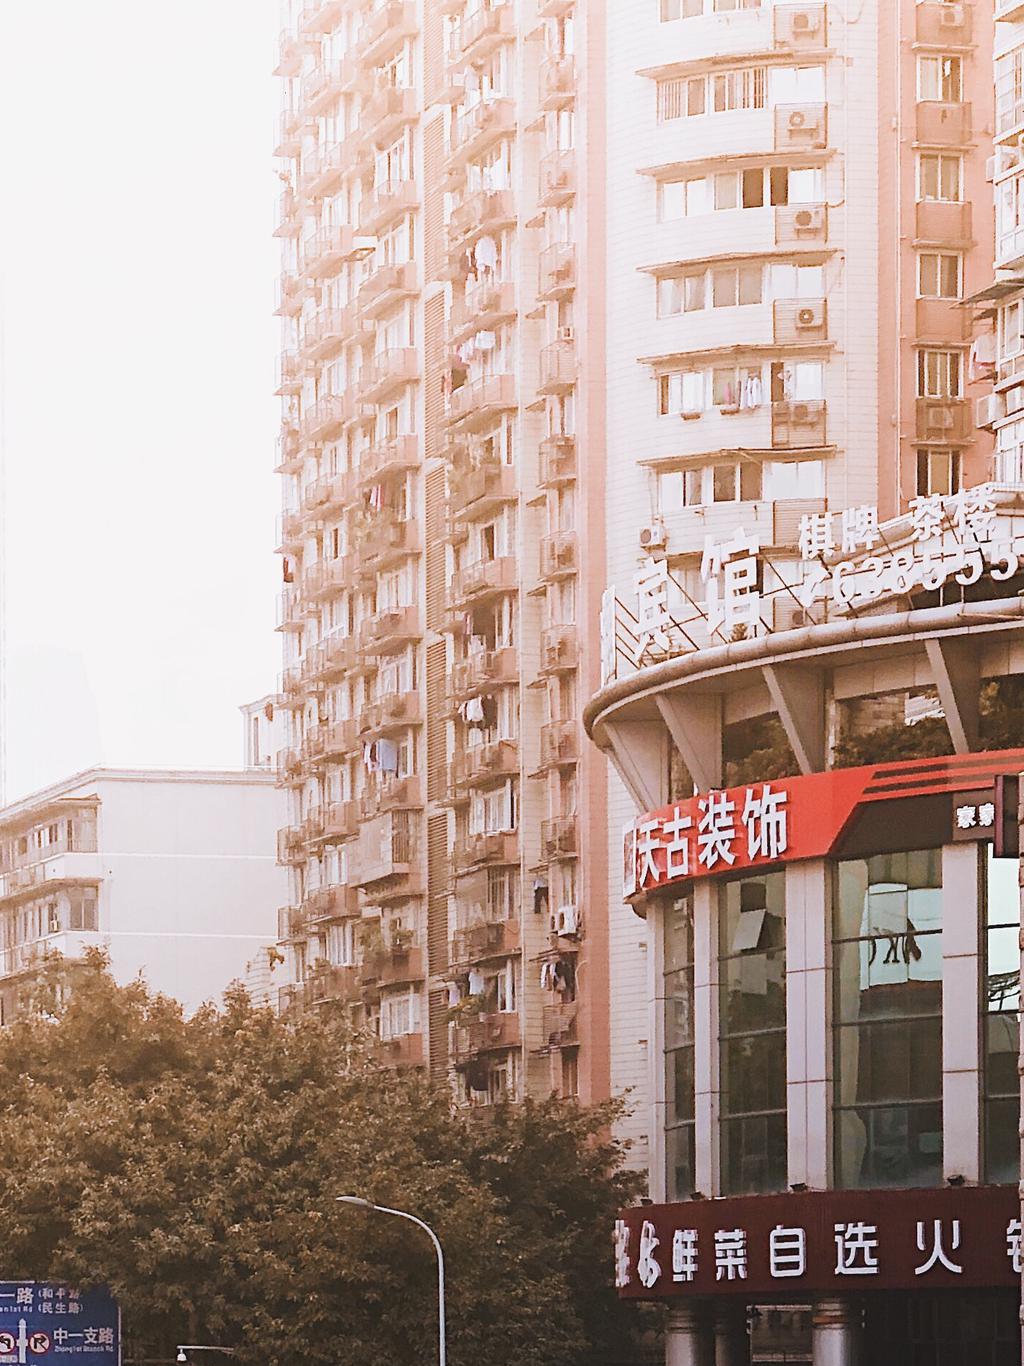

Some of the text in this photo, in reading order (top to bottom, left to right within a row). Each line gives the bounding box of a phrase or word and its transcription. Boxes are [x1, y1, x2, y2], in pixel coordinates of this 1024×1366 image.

[798, 505, 880, 560] 棋牌
[53, 1327, 114, 1345] 中一支路
